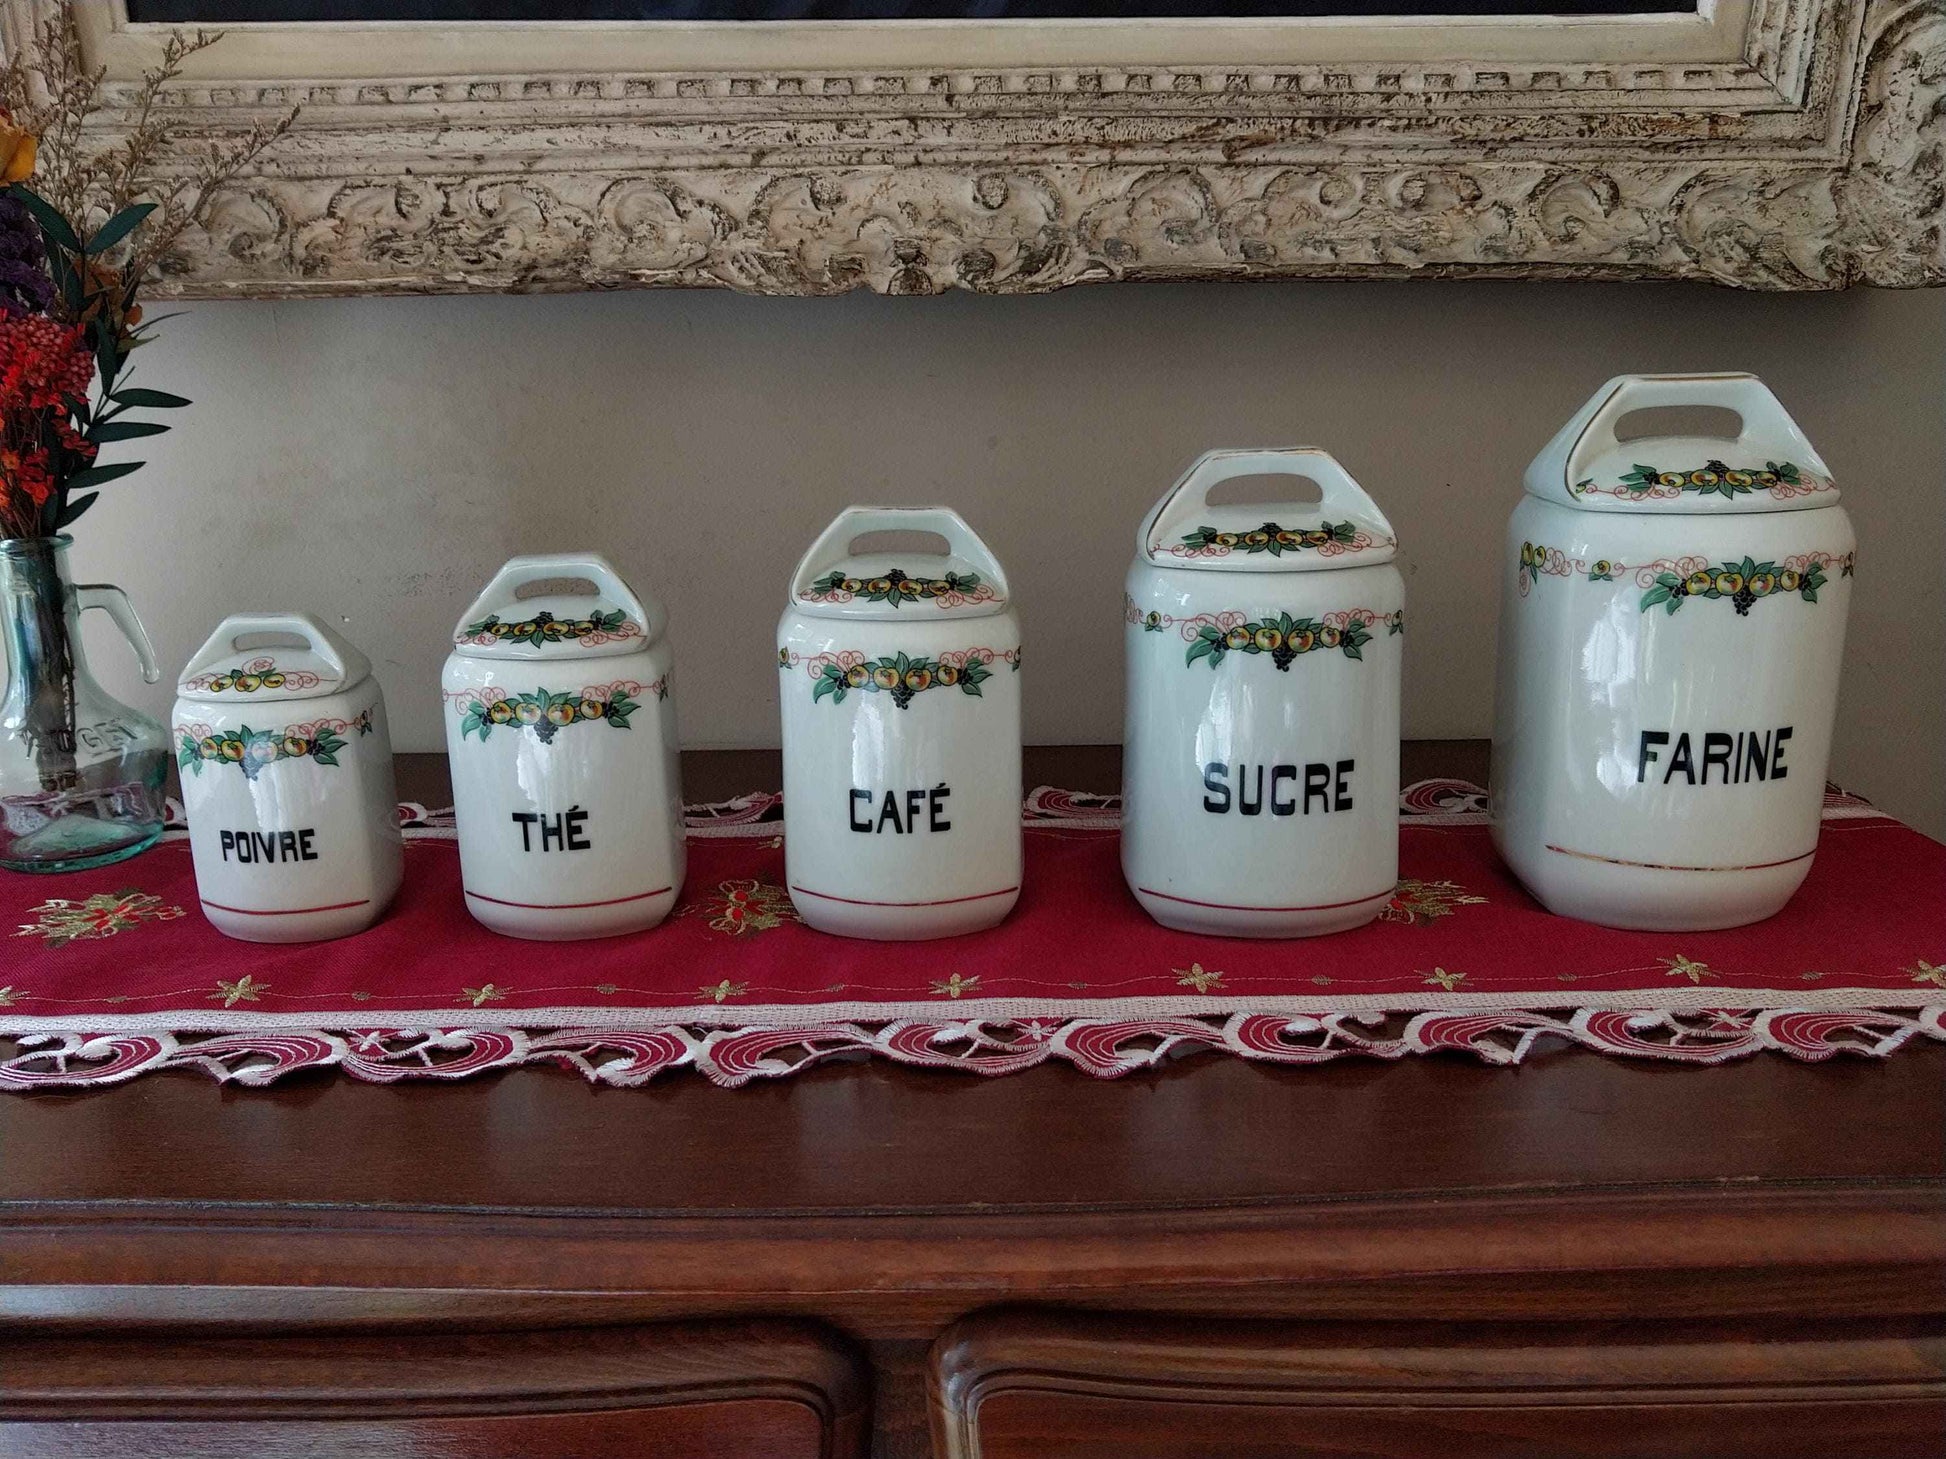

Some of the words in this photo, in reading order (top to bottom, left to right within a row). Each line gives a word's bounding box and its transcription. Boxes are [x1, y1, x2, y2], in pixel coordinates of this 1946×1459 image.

[1637, 726, 1794, 786] FARINE
[849, 782, 951, 834] CAFÉ
[1203, 759, 1355, 817] SUCRE
[220, 828, 319, 864] POIVRE
[511, 804, 591, 852] THÉ
